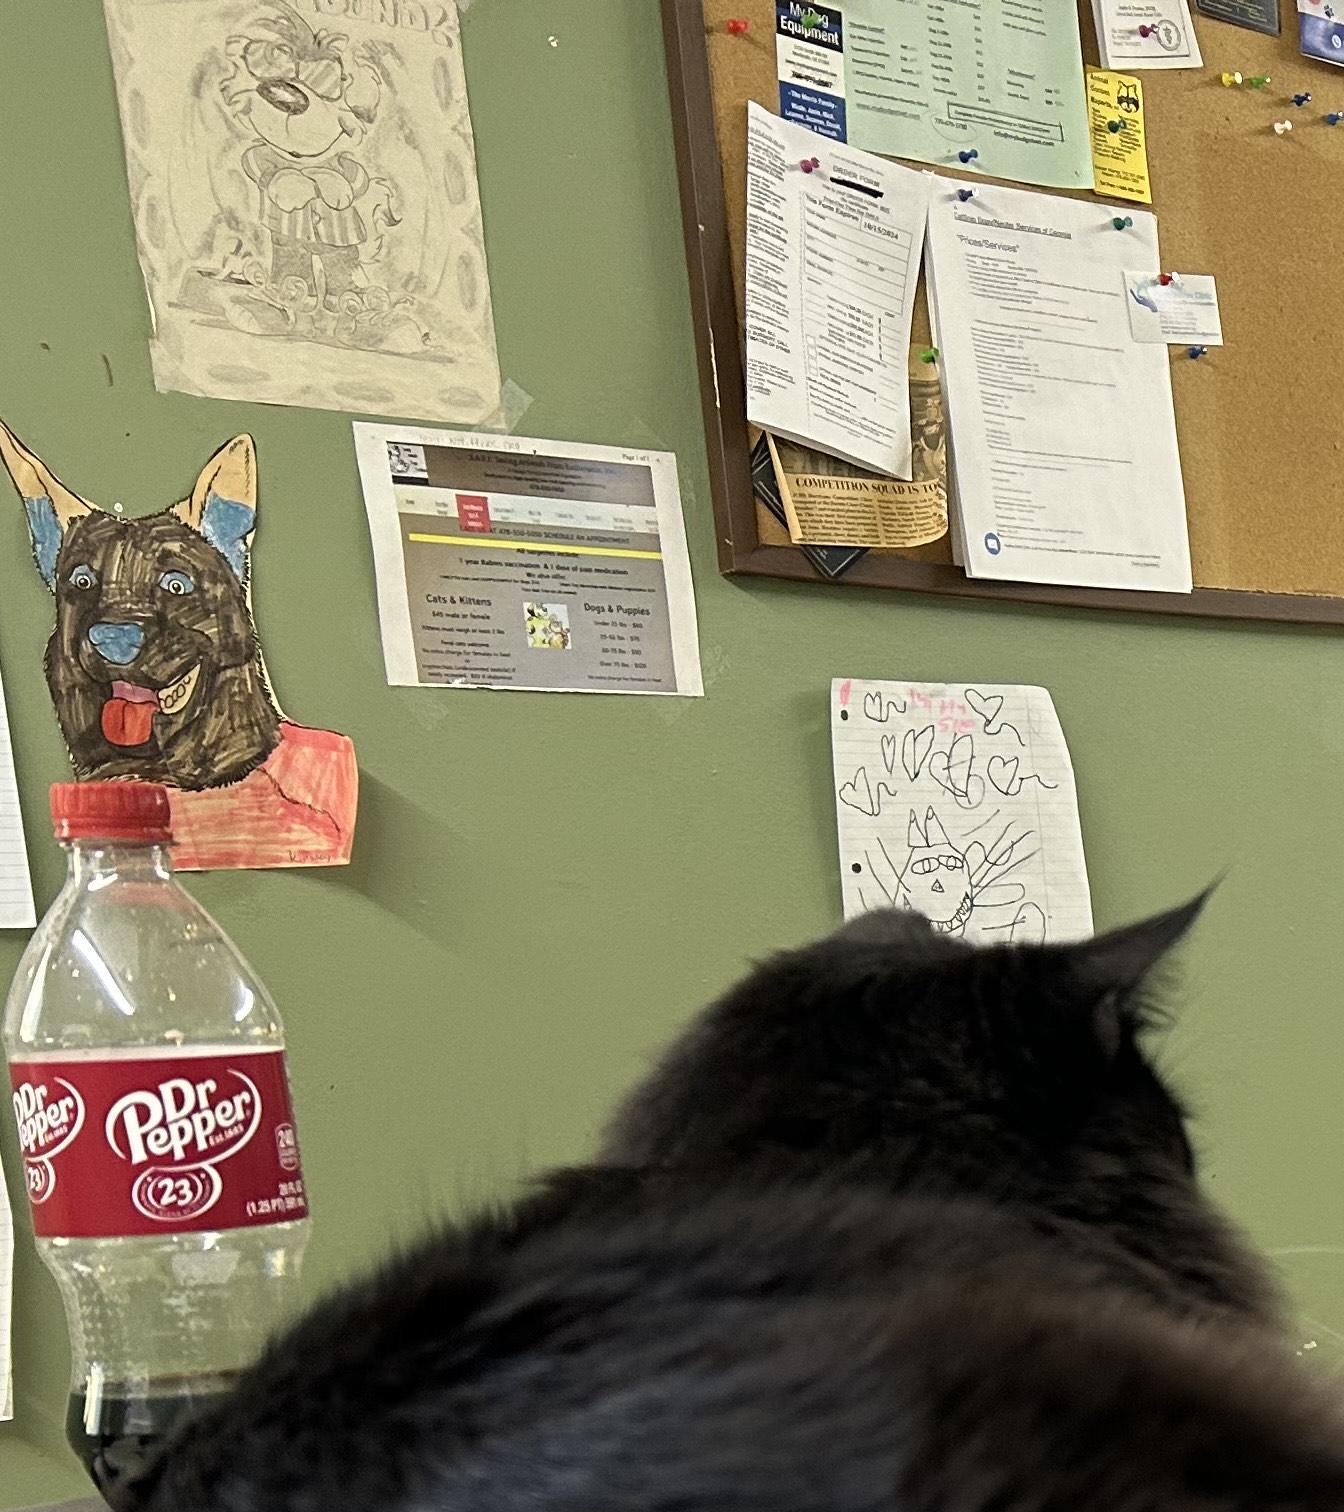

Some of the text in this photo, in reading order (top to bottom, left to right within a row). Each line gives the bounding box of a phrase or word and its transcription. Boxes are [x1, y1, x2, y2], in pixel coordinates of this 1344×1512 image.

[780, 15, 839, 45] Equipment
[796, 478, 869, 492] COMPETITION
[871, 484, 905, 495] SQUAD
[907, 484, 919, 494] IS
[426, 594, 447, 605] Cats
[459, 595, 492, 607] Kittens
[584, 602, 605, 615] Dogs
[616, 604, 651, 616] Puppies
[20, 1082, 47, 1119] Dr
[158, 1078, 217, 1123] Dr
[106, 1091, 250, 1165] Pepper
[157, 1177, 194, 1206] 23
